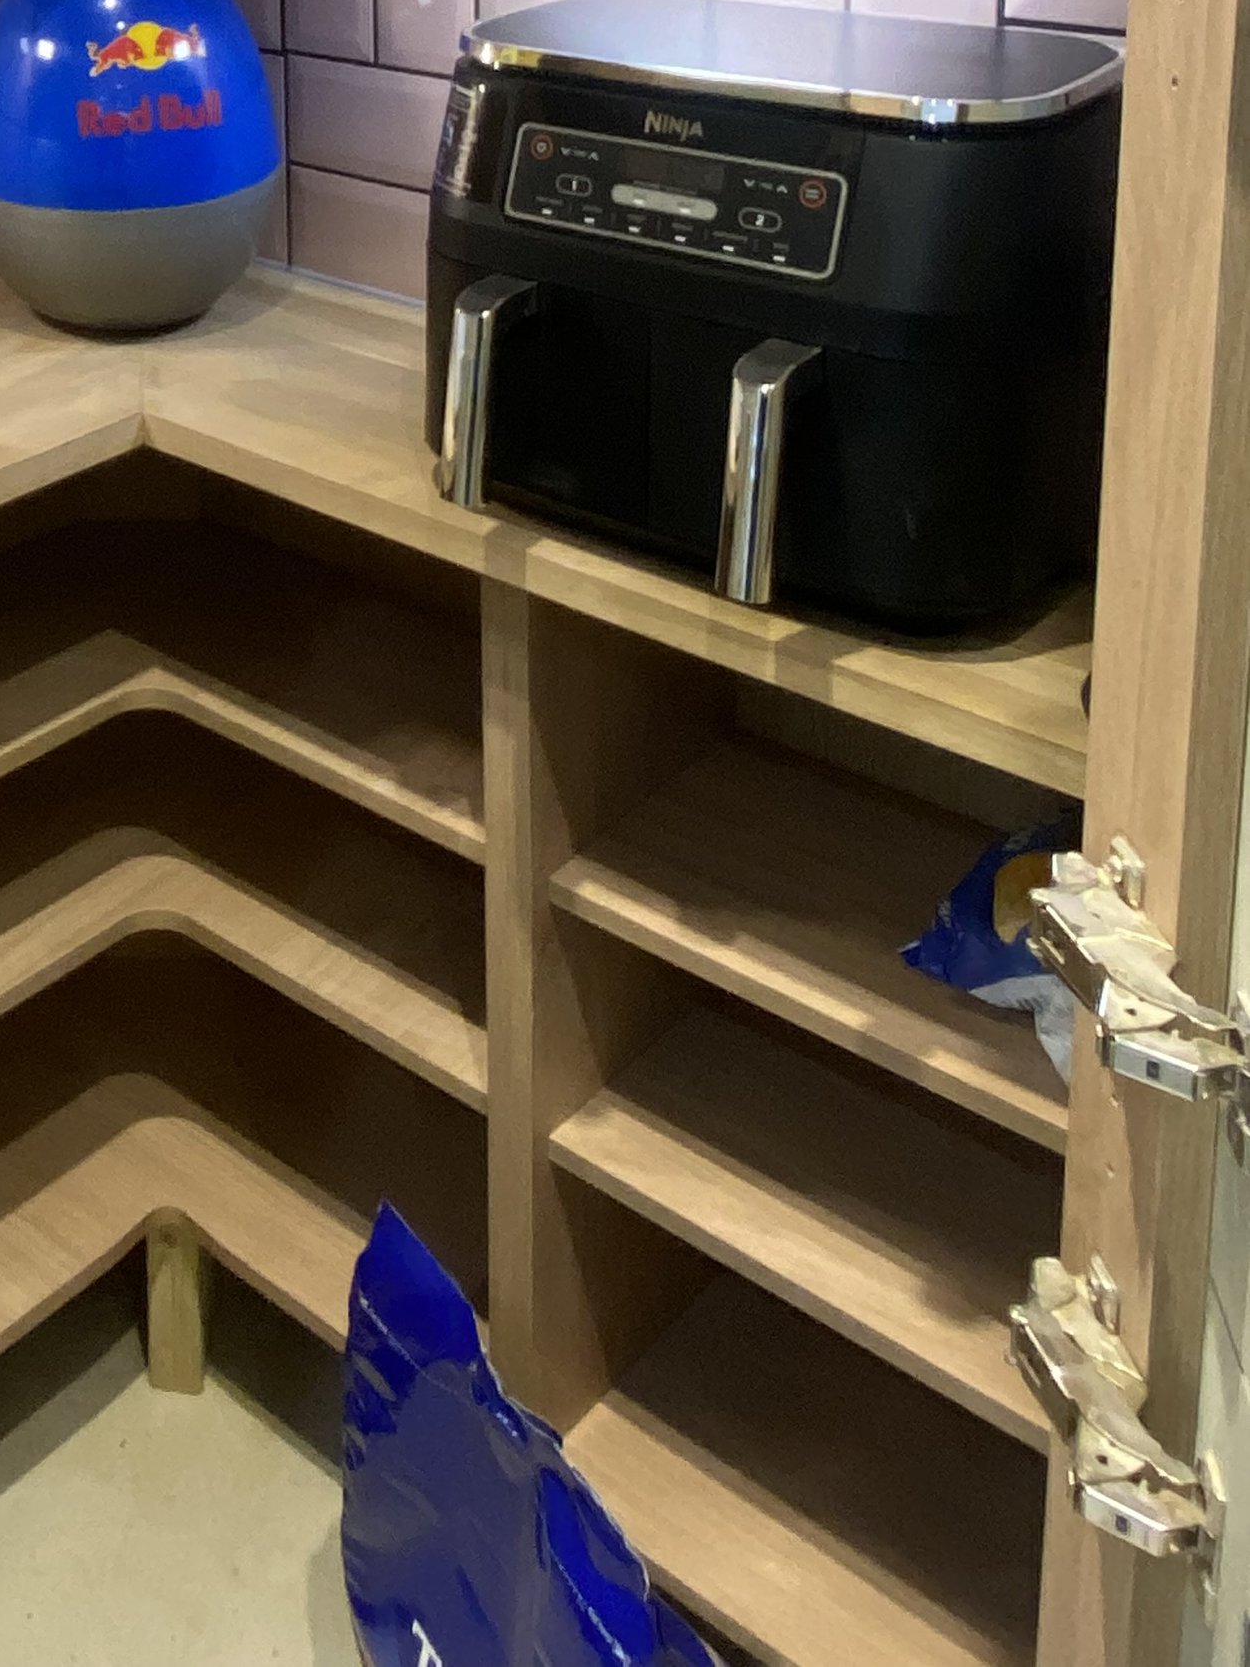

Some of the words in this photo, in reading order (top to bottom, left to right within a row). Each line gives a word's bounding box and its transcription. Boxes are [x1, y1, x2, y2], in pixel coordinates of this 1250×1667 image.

[76, 94, 152, 138] Red
[157, 89, 223, 131] Bull
[643, 109, 705, 142] NINJA
